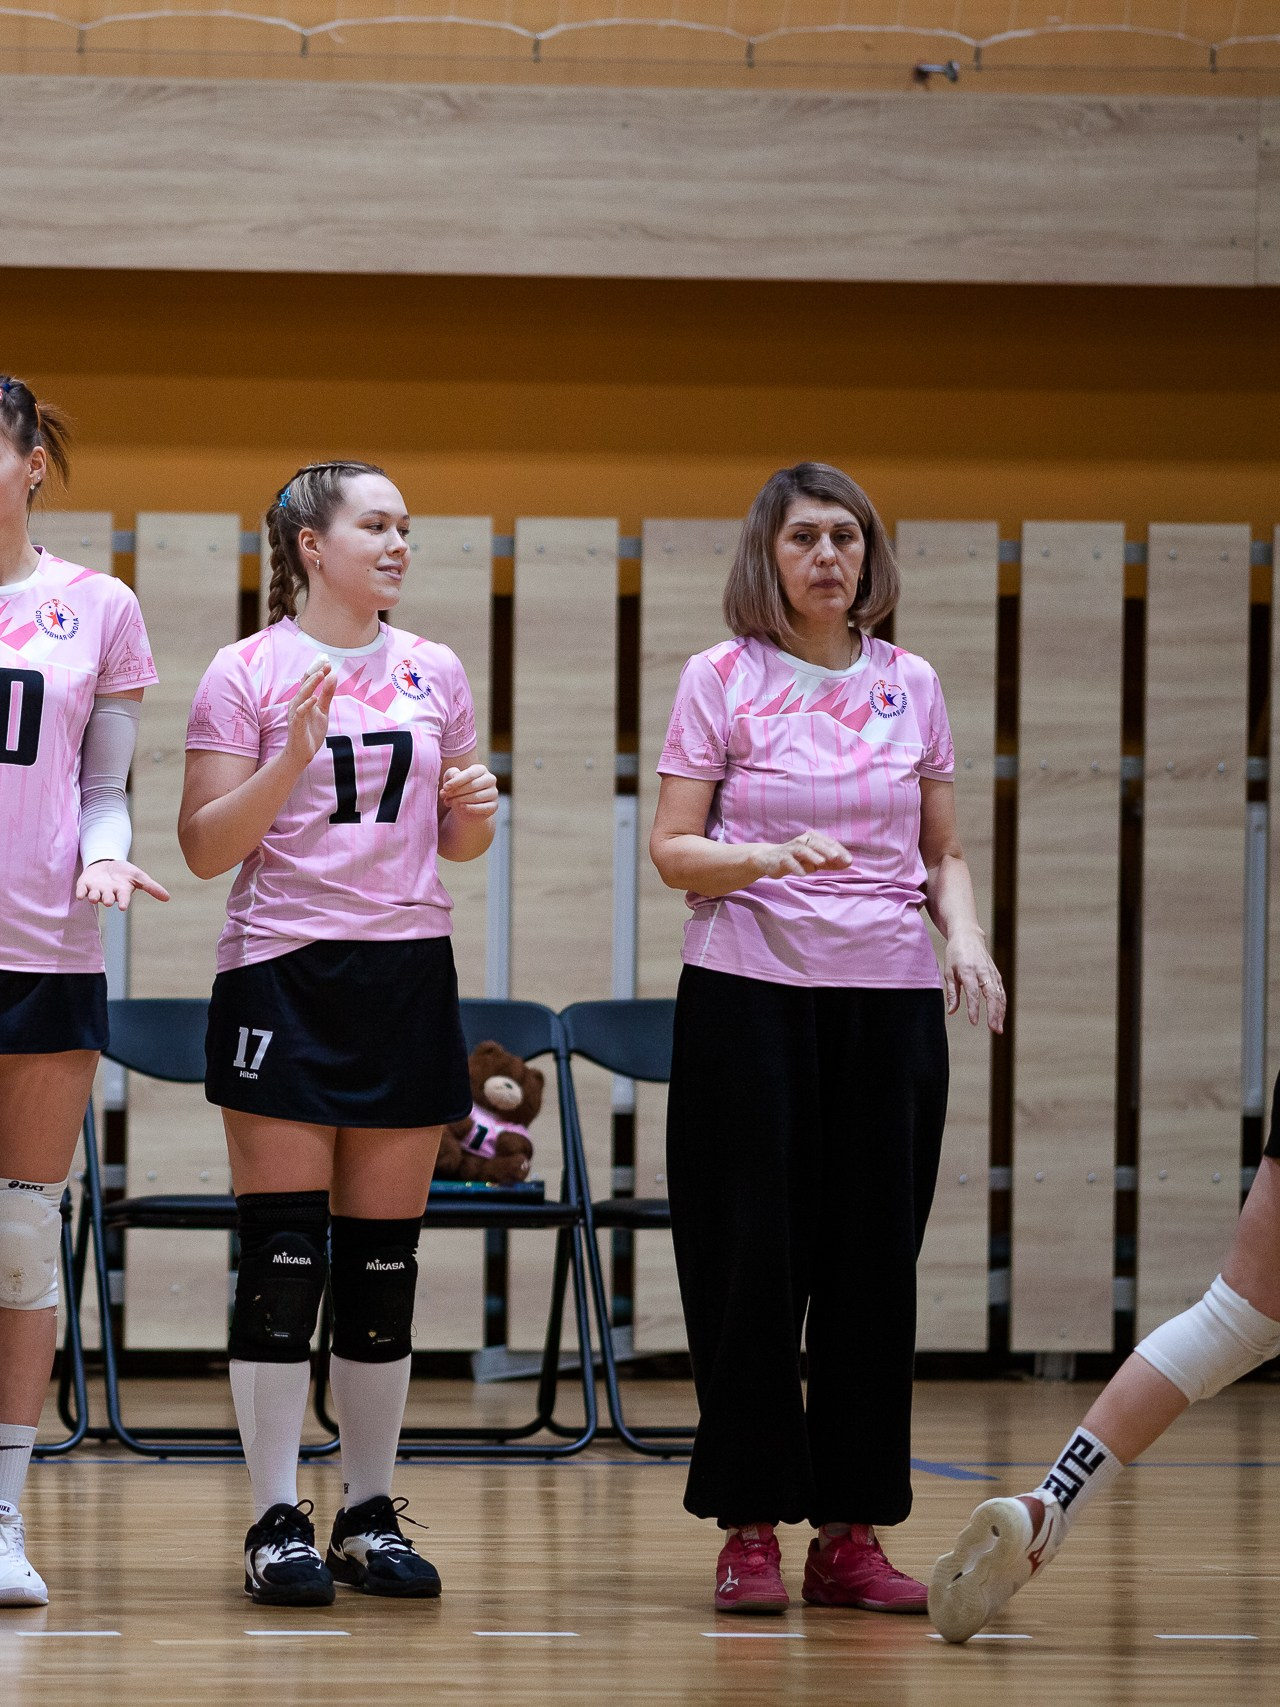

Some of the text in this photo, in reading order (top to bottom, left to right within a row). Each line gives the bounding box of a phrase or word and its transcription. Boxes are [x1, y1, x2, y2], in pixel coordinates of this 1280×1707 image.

[35, 610, 79, 640] СПОРТИВНАЯ ШКОЛА
[869, 690, 901, 719] СПОРТИВНАЯ
[325, 730, 414, 825] 17
[233, 1026, 274, 1070] 17
[239, 1070, 259, 1080] Hitch
[19, 1183, 45, 1192] asics
